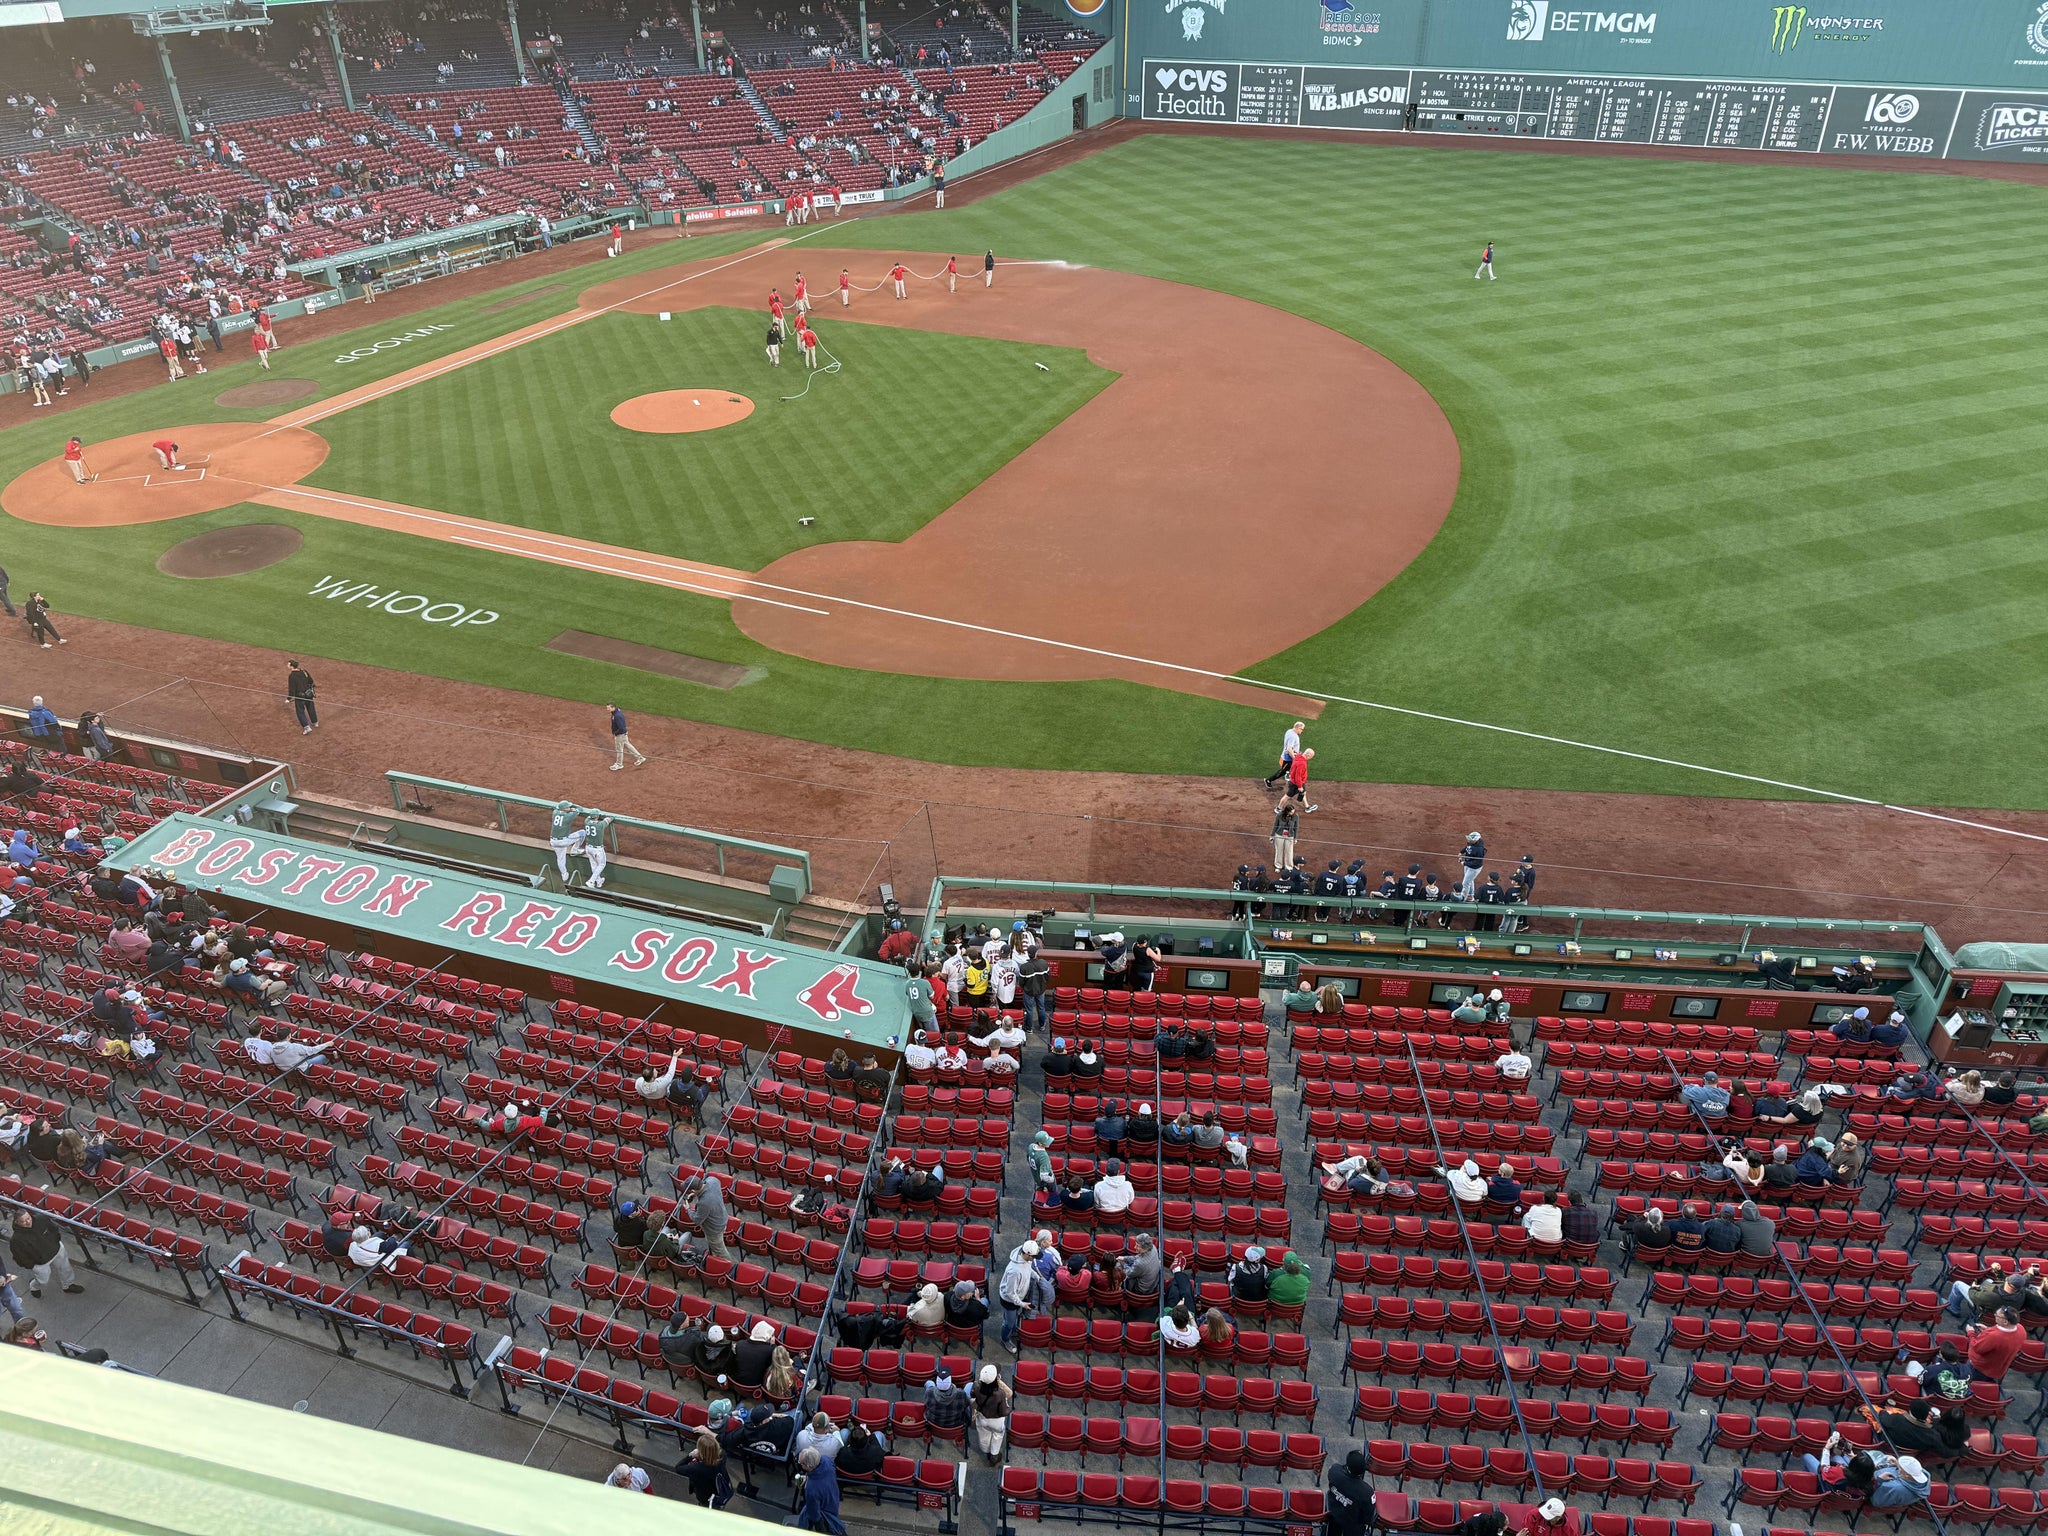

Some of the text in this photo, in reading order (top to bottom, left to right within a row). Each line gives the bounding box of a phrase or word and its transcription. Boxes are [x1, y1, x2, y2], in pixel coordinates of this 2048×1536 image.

[1325, 13, 1380, 25] RED SOX
[1551, 11, 1658, 34] BETMGM
[1325, 23, 1380, 34] SCHOLARS
[1323, 35, 1352, 46] BIDMC
[1178, 68, 1228, 93] CVS
[1438, 74, 1524, 84] FENWAY PARK
[1566, 79, 1610, 87] AMERICAN
[1304, 85, 1321, 94] WHO
[1705, 84, 1787, 94] NATIONAL LEAGUE
[1128, 94, 1140, 103] 310
[1156, 92, 1226, 116] Health
[1363, 107, 1384, 115] SINCE
[1441, 113, 1456, 121] BALL
[1463, 114, 1485, 122] STRIKE
[1833, 133, 1935, 153] F.W. WEBB
[859, 192, 879, 200] TRULY
[686, 211, 715, 221] afelite
[334, 324, 456, 364] WHOOP
[307, 575, 500, 628] WHOOP
[553, 815, 565, 827] 81
[585, 825, 598, 838] 83
[150, 828, 788, 1001] BOSTON RED SOX
[910, 987, 919, 1000] 19
[923, 1500, 938, 1508] 20
